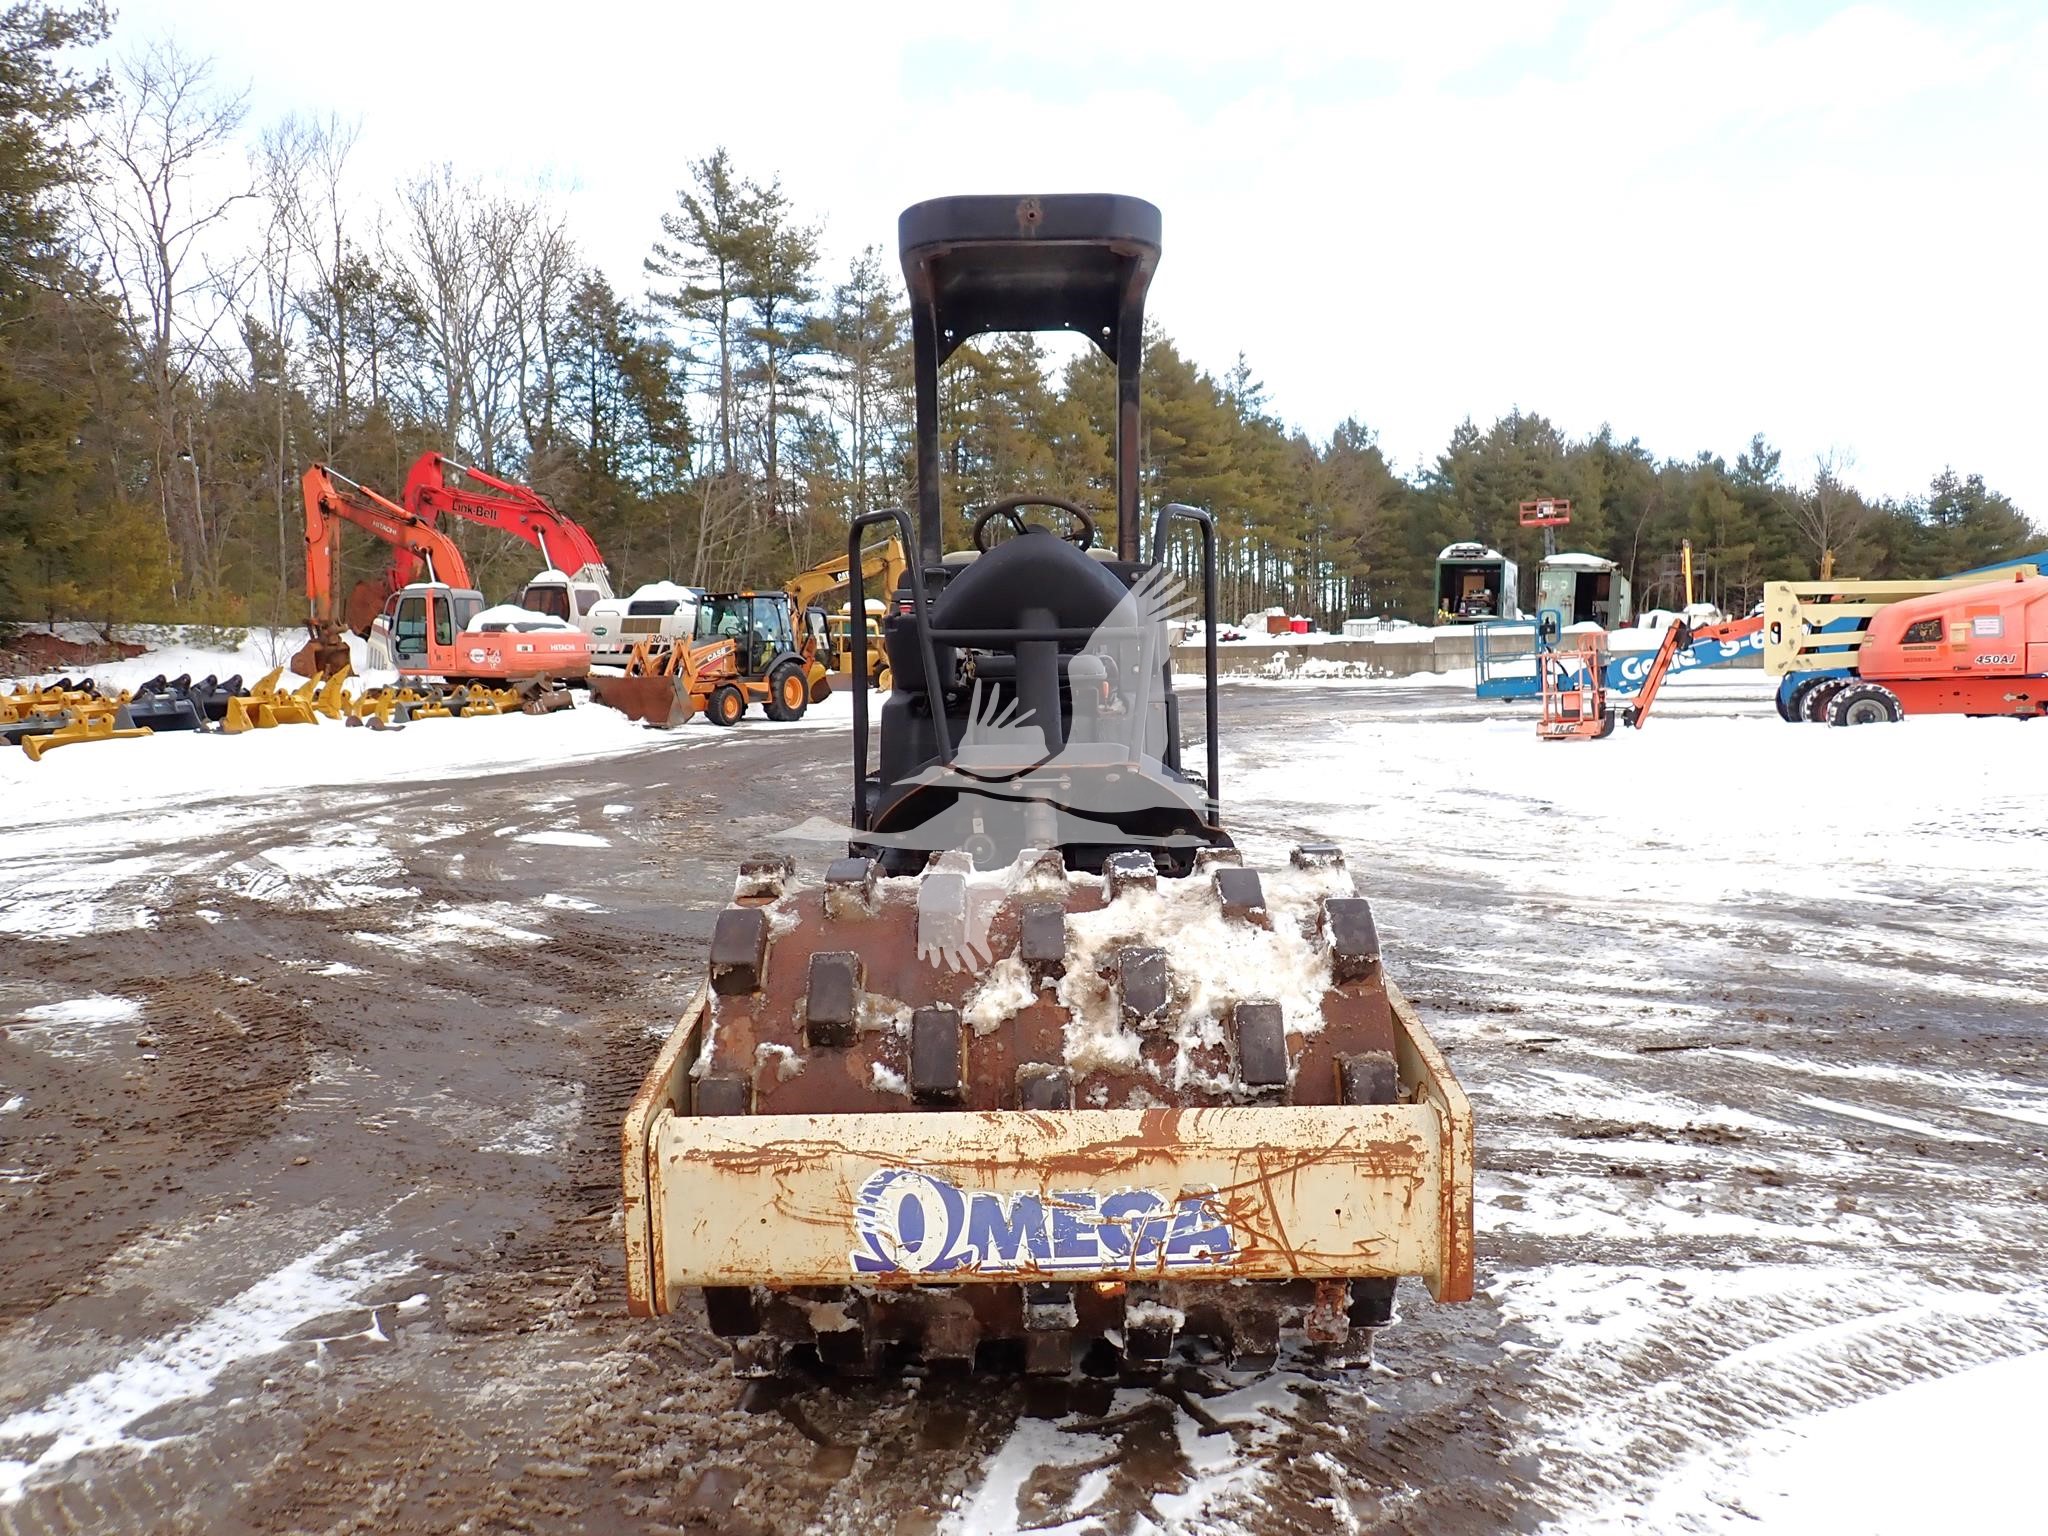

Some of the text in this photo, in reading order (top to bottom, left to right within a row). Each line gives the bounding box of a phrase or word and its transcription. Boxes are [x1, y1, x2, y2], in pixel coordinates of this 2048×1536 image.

[452, 498, 497, 520] Link-Belt
[550, 643, 575, 652] HITACHI
[707, 647, 726, 662] CASE
[1975, 654, 2016, 665] 450AJ
[852, 1168, 1238, 1272] OMEGA
